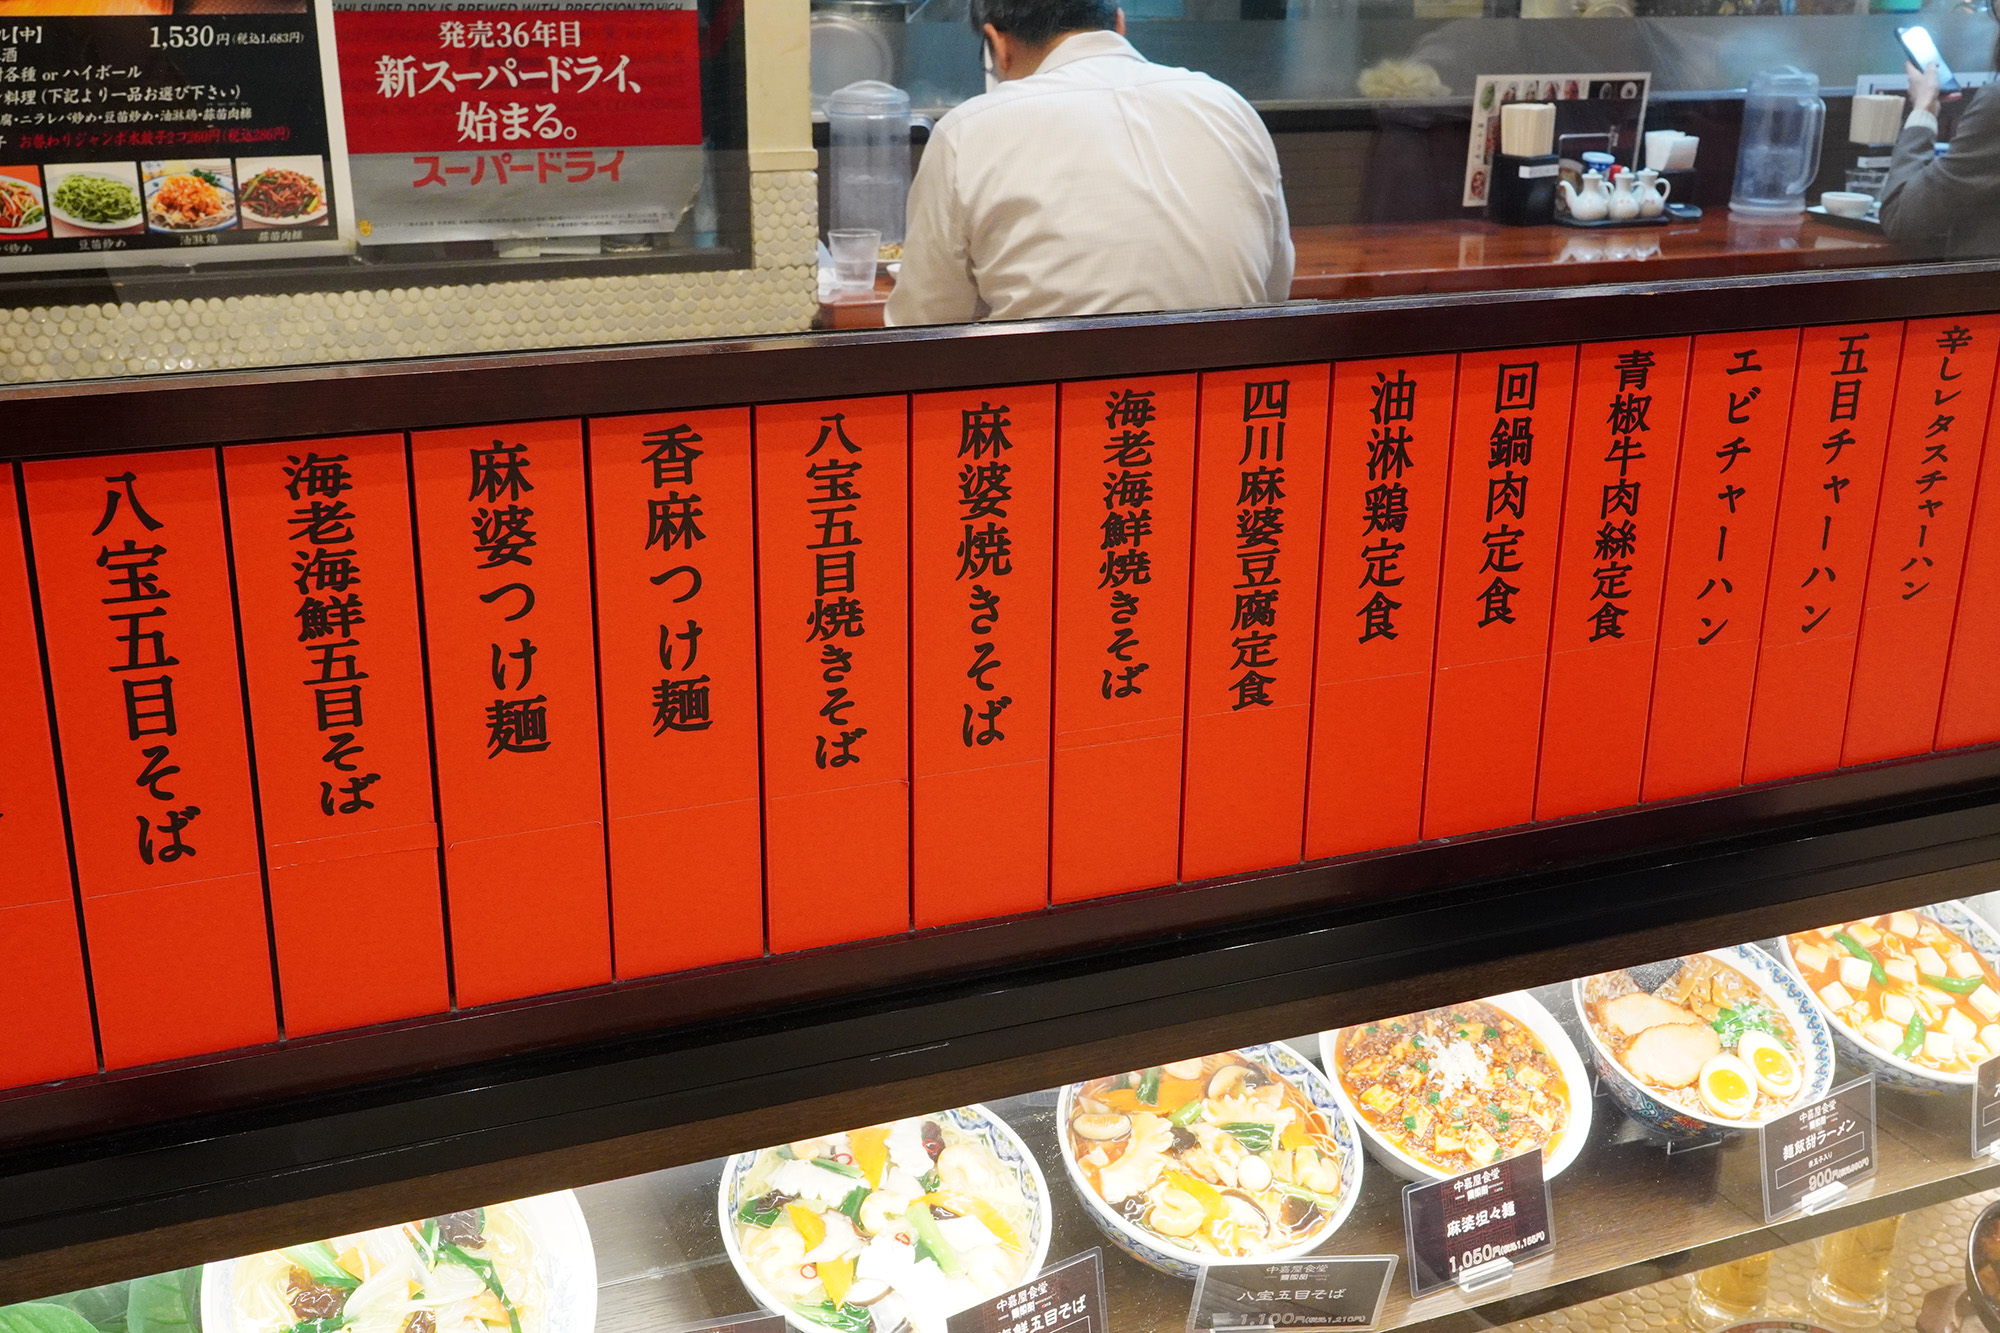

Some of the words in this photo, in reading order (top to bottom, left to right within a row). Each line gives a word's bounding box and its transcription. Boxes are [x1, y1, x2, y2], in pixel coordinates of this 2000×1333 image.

[42, 72, 58, 80] or
[63, 64, 142, 81] ハイボール
[375, 54, 642, 98] 新スーパードライ、
[413, 150, 625, 188] スーパードライ
[438, 20, 581, 48] 発売36年目
[456, 101, 577, 143] 始まる。
[468, 439, 552, 759] 麻婆つけ麺
[641, 423, 714, 737] 香麻つけ麺
[805, 412, 867, 769] 八宝五目焼きそば
[955, 401, 1013, 748] 麻婆焼きそば
[1097, 388, 1156, 700] 海老海鮮焼きそば
[1228, 379, 1291, 712] 四川麻婆豆腐定食
[1356, 369, 1417, 645] 油淋鶏定食
[1476, 360, 1540, 629] 回鍋肉定食
[1696, 349, 1763, 646] エビチャーハン
[1801, 333, 1869, 634] 五目チャーハン
[1900, 325, 1974, 601] 辛しレタスチャーハン
[92, 471, 201, 865] 八宝五目そば
[282, 452, 381, 816] 海老海鮮五目そば
[1236, 1288, 1347, 1302] 八宝五目そば
